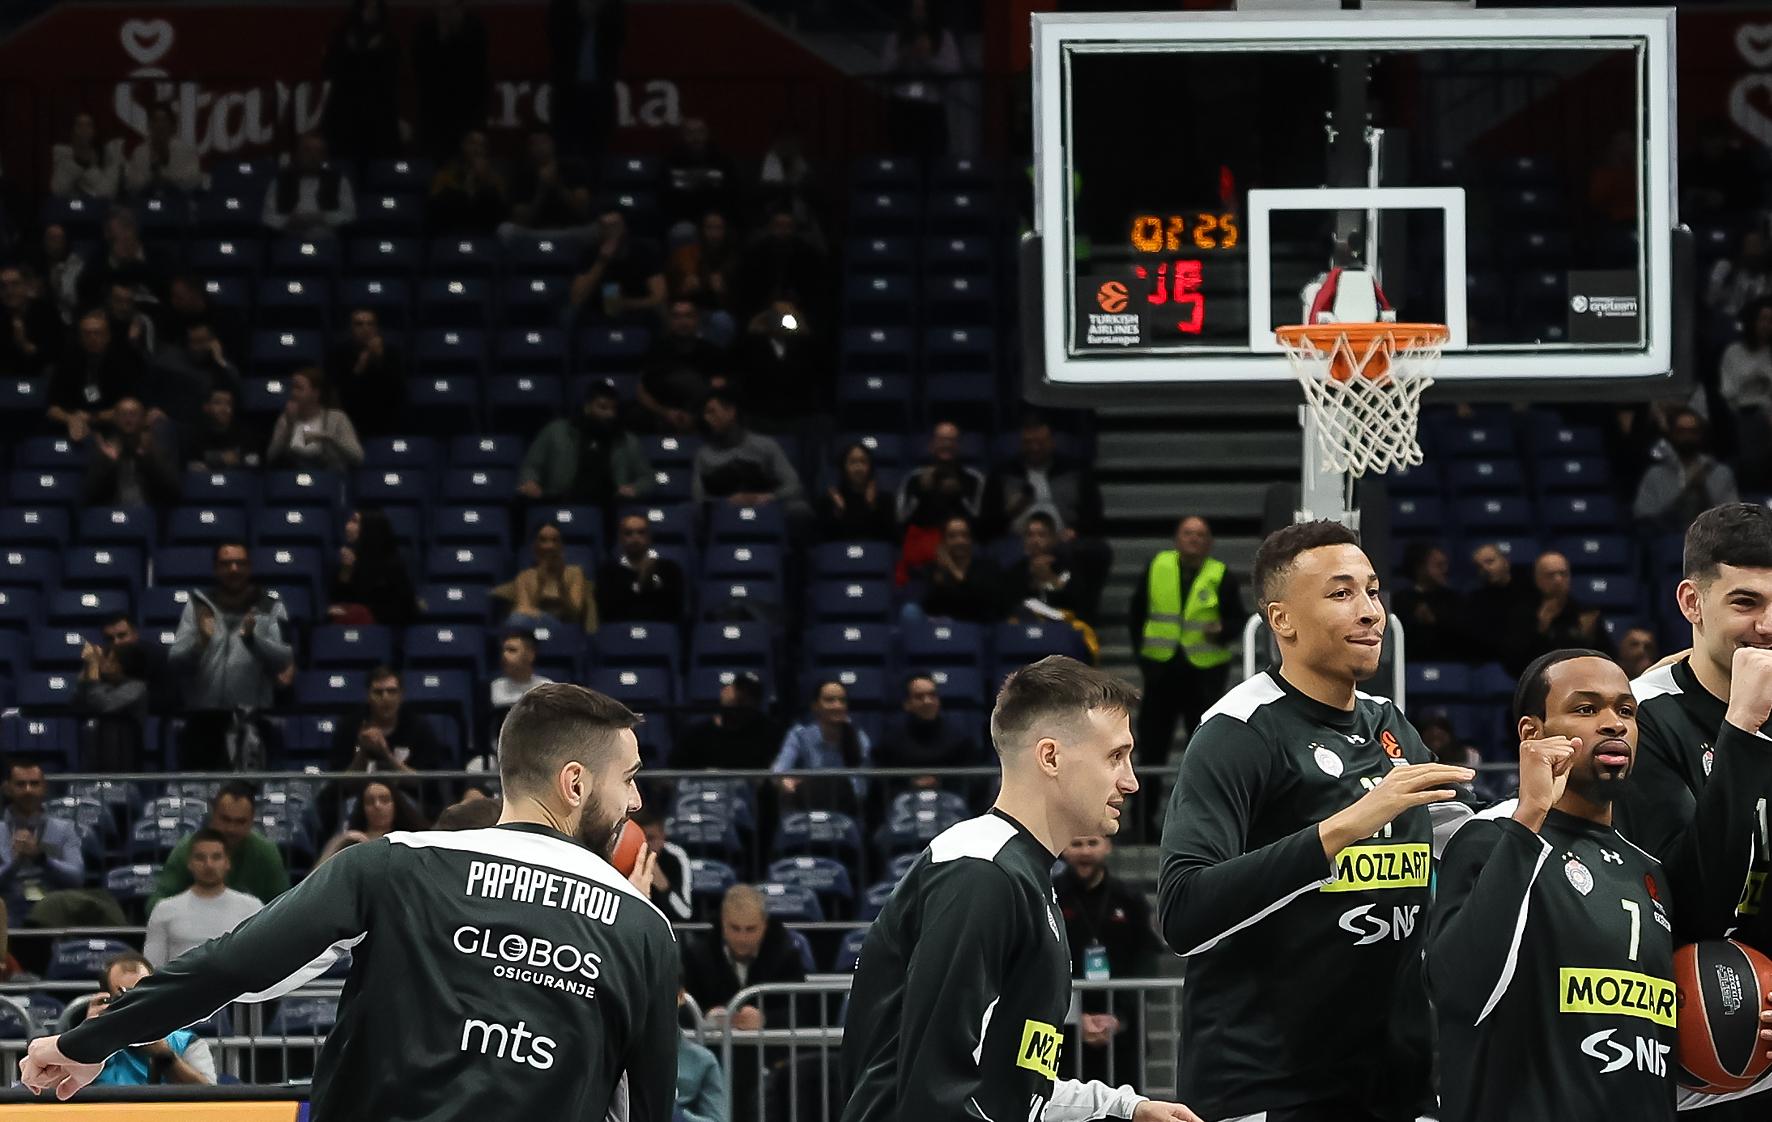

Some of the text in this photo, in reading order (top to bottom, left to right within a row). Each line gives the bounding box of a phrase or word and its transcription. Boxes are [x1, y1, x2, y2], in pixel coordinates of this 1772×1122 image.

[466, 861, 621, 926] PAPAPETROU
[453, 926, 602, 980] GLOBOS
[1621, 898, 1641, 961] 7
[493, 965, 596, 999] OSIGURANJE
[1567, 975, 1676, 1018] MOZZAR
[460, 1019, 557, 1070] mts
